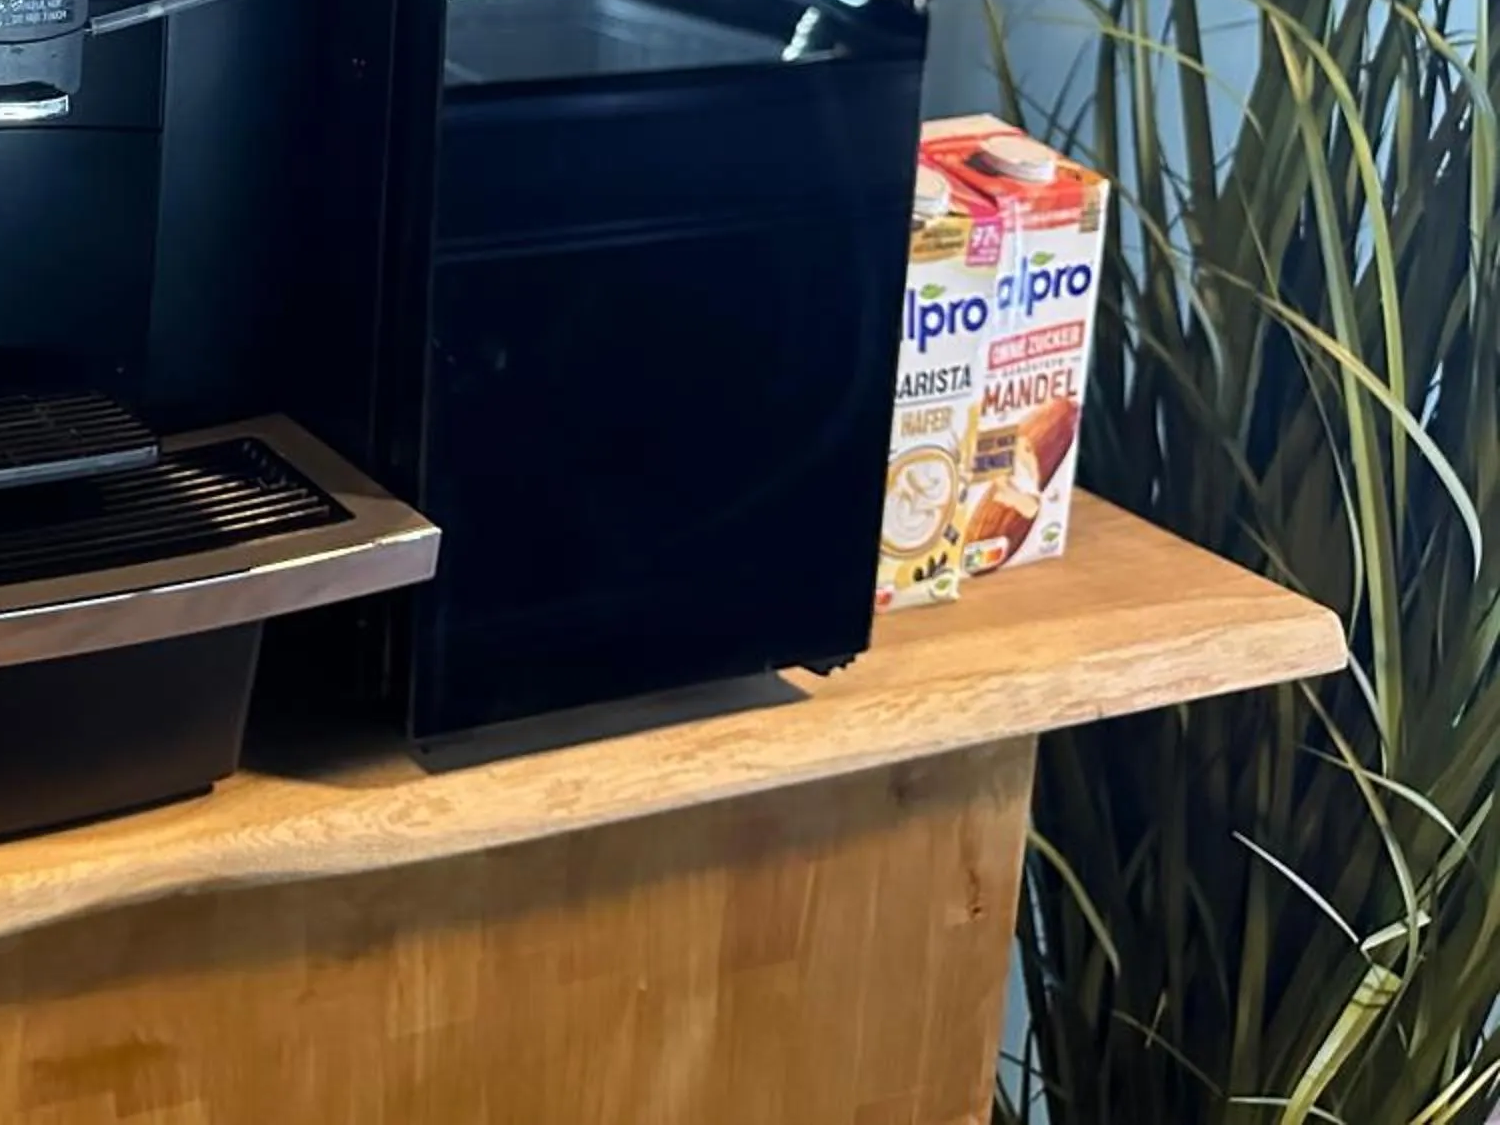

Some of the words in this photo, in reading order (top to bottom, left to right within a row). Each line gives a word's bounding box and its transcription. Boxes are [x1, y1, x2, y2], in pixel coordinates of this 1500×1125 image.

[997, 256, 1092, 316] alpro
[901, 288, 989, 353] lpro
[895, 363, 972, 399] ARISTA
[981, 369, 1078, 417] MANDEL
